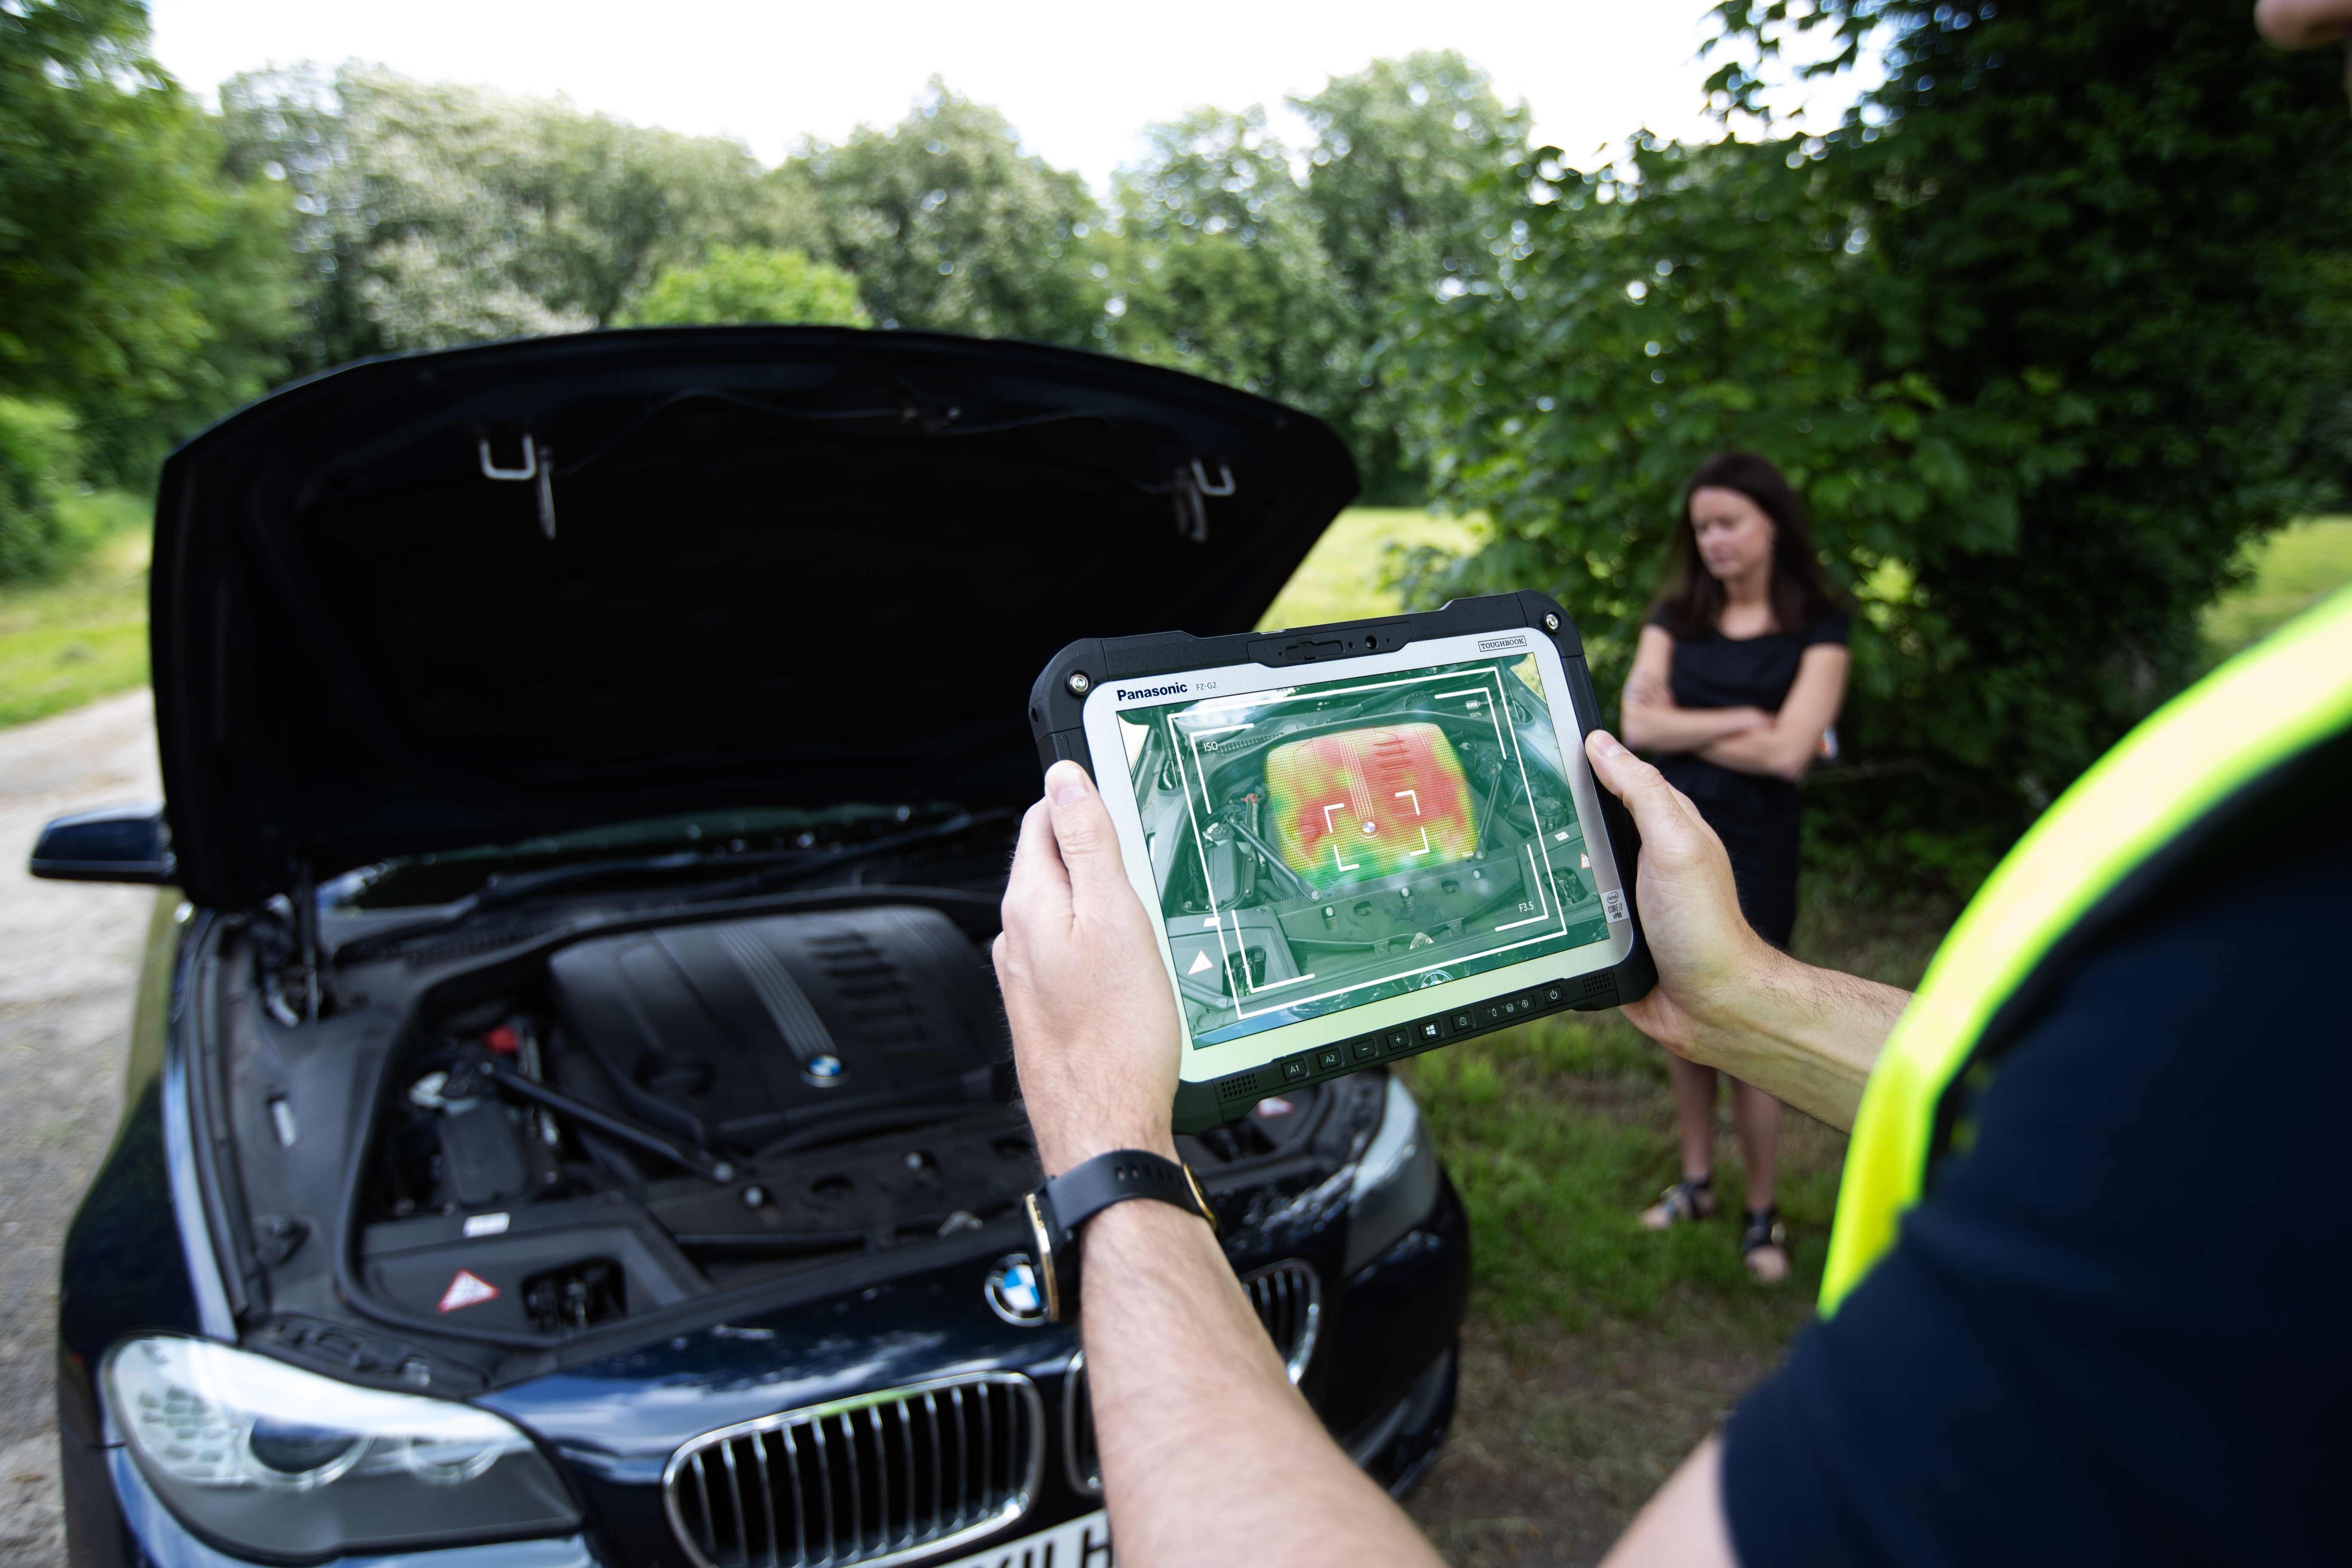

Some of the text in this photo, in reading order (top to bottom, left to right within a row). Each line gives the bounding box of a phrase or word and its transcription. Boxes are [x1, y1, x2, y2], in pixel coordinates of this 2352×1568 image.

[1480, 638, 1525, 649] TOUGHBOOK
[1117, 682, 1217, 701] Panasonic FZ-G2
[1204, 741, 1218, 751] ISO
[1519, 901, 1534, 912] F3.5
[1608, 904, 1619, 913] CORE
[1326, 1055, 1335, 1063] A2
[1290, 1064, 1299, 1073] A1
